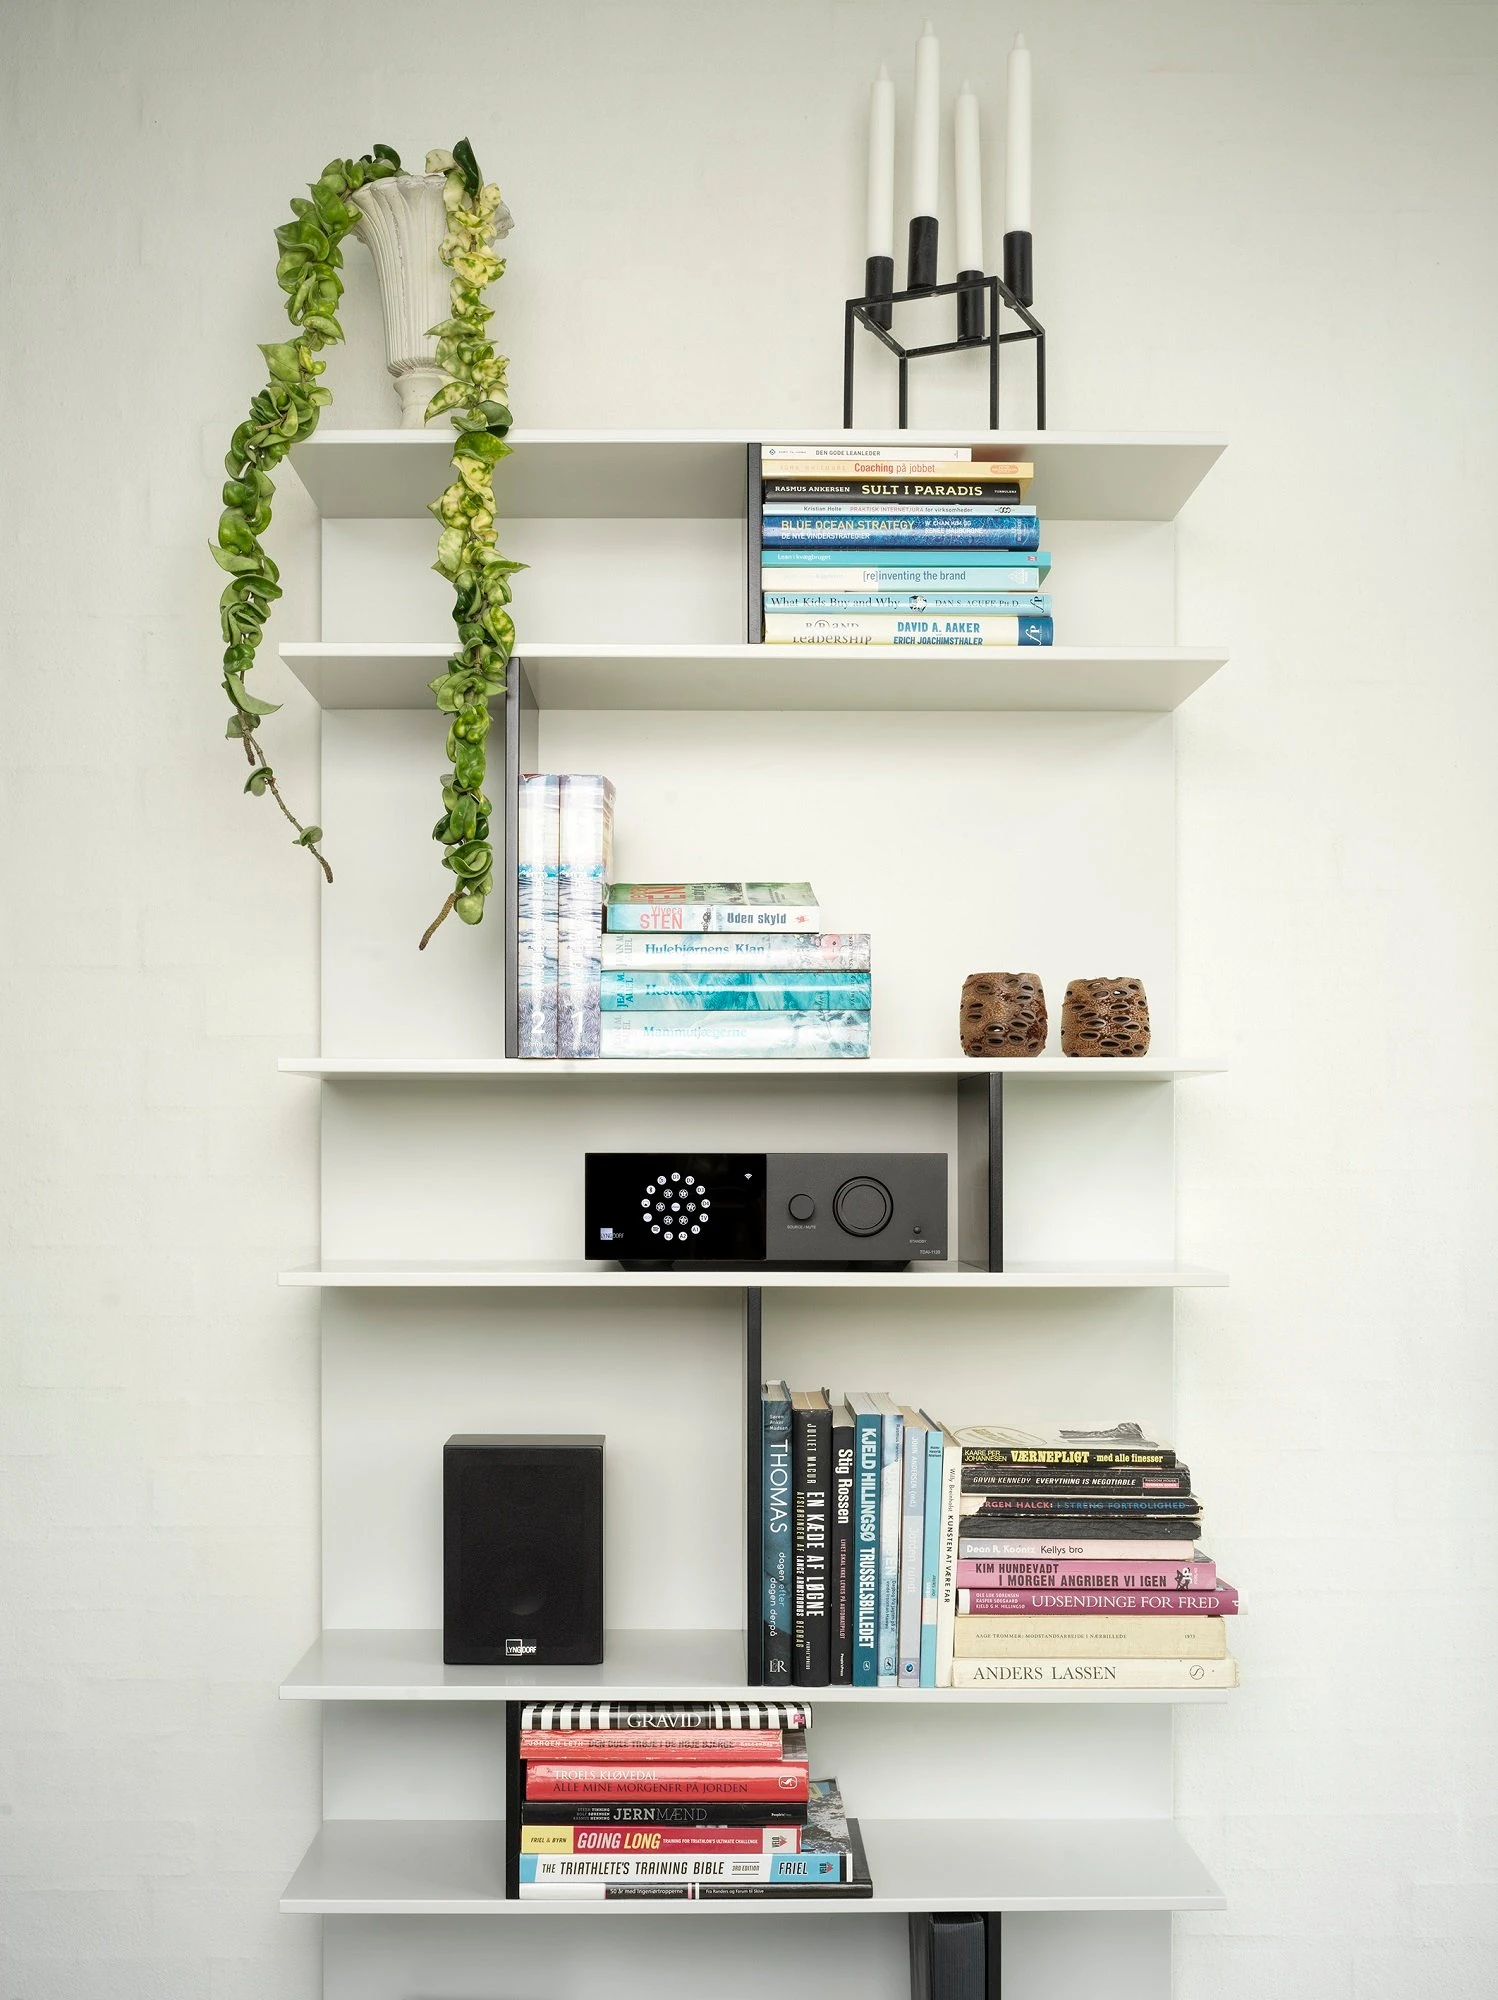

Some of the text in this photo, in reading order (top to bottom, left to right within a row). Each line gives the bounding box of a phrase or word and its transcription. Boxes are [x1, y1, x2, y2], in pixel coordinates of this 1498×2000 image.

[854, 463, 894, 474] Coaching
[896, 464, 907, 474] på
[909, 464, 935, 474] jobbet
[861, 485, 983, 496] SULT I PARADIS
[781, 520, 915, 530] BLUE OCEAN STRATEGY
[923, 571, 938, 581] the
[939, 571, 966, 581] brand
[771, 597, 900, 610] What Kids Buy and Why
[897, 621, 980, 633] DAVID A. AAKER
[893, 636, 983, 646] ERICH JOACHIMSTHALER
[651, 906, 683, 916] Viveca
[639, 914, 683, 930] STEN
[727, 912, 754, 924] Uden
[757, 912, 787, 926] skyld
[531, 1011, 545, 1034] 2
[571, 1011, 584, 1034] 1
[911, 1437, 919, 1454] JOHN
[806, 1423, 817, 1484] JULIET MACUR
[1010, 1450, 1164, 1463] VÆRNEPLIGT alle finesser
[910, 1456, 918, 1489] ANDERSEN
[948, 1468, 956, 1483] Willy
[770, 1438, 788, 1533] THOMAS
[835, 1448, 853, 1524] Stig Rossen
[1092, 1478, 1136, 1486] NEGOTIABLE
[1016, 1501, 1053, 1509] HALCK:
[858, 1428, 877, 1649] KJELD HILLINGSØ TRUSSELSBILLEDET
[946, 1515, 954, 1552] KUNSTEN
[806, 1491, 825, 1617] EN KÆDE AF LØGNE
[966, 1545, 1084, 1556] Dean R. Koontz Kellys bro
[945, 1554, 952, 1563] AT
[795, 1491, 805, 1648] AFSLØRINGEN AF LANCE ARMSTRONGS BEDRAG
[975, 1563, 1060, 1574] KIM HUNDEVADT
[777, 1552, 786, 1607] dagen efter
[944, 1567, 952, 1587] VÆRE
[999, 1575, 1167, 1587] I MORGEN ANGRIBER VI IGEN
[943, 1589, 951, 1603] FAR
[1031, 1595, 1137, 1608] UDSENDINGE
[1140, 1596, 1174, 1608] FOR
[1178, 1596, 1220, 1609] FRED
[768, 1577, 777, 1637] dagen derpå
[506, 1646, 537, 1654] LYNGDORF
[973, 1666, 1117, 1680] ANDERS LASSEN
[627, 1712, 702, 1728] GRAVID
[555, 1769, 658, 1780] TROELS KLØVEDAL
[553, 1782, 748, 1794] ALLE MINE MORGENER PÅ JORDEN
[613, 1807, 708, 1821] JERNMÆND
[577, 1832, 662, 1849] GOING LONG
[542, 1863, 556, 1873] THE
[560, 1861, 630, 1875] TRIATHLETE'S
[635, 1861, 688, 1875] TRAINING
[693, 1861, 725, 1875] BIBLE
[778, 1862, 808, 1875] FRIEL
[636, 1888, 683, 1897] Ingeniørtropperne
